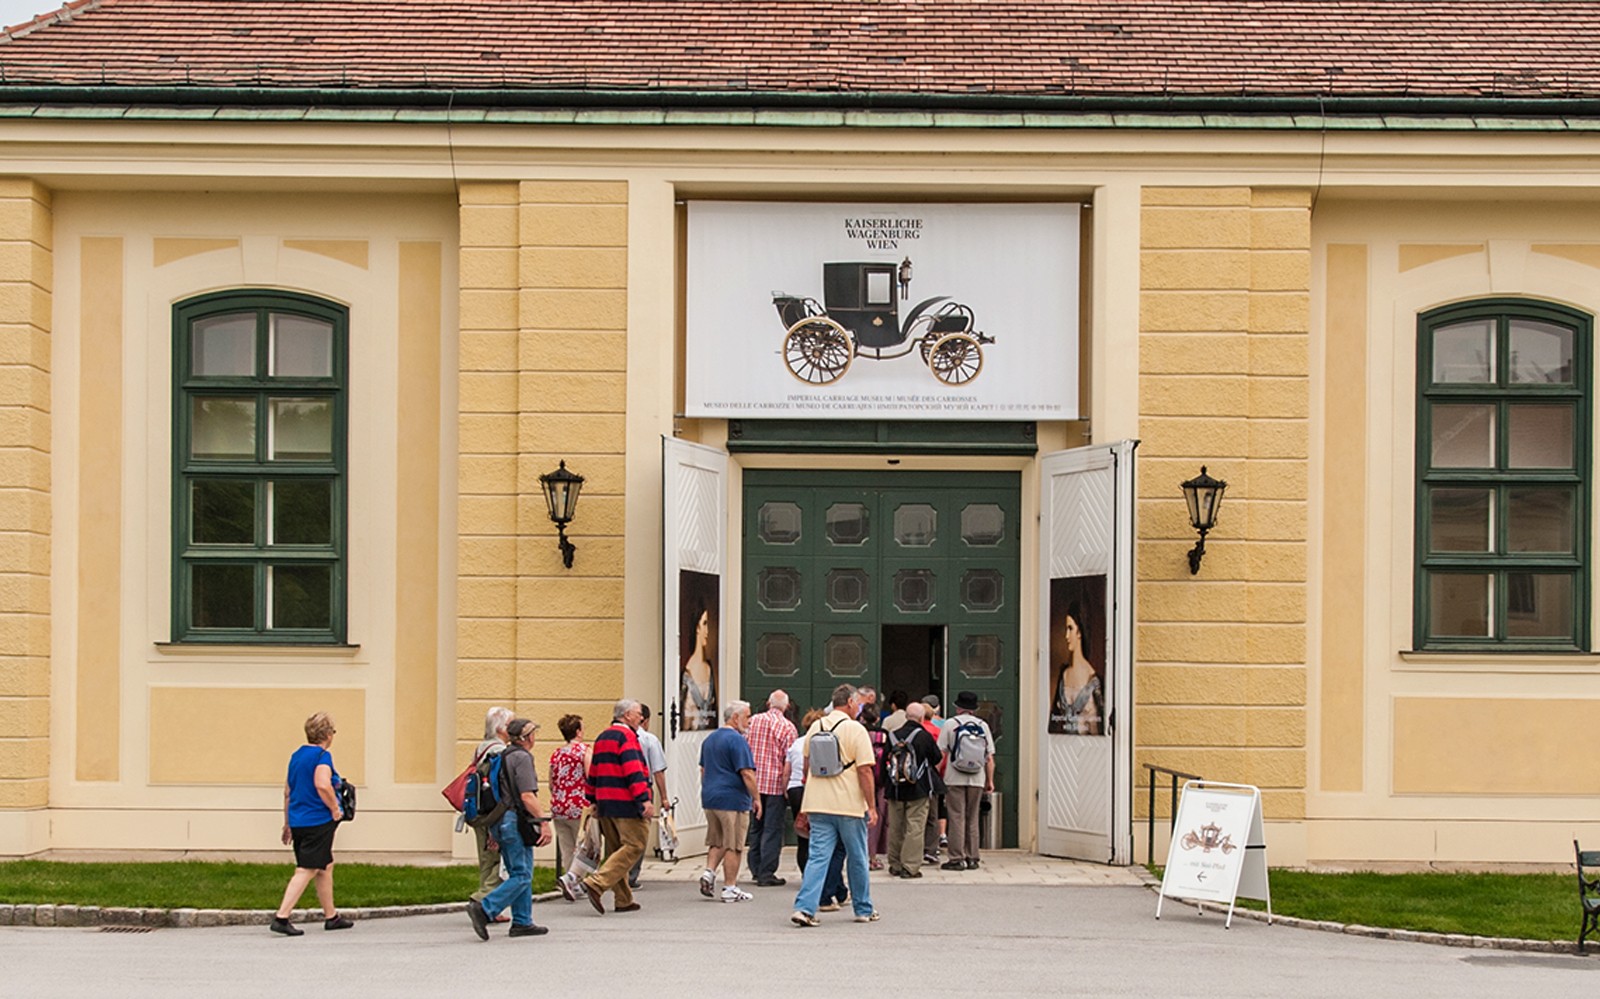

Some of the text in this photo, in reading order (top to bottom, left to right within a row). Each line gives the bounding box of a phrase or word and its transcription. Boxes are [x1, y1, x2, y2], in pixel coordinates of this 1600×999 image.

[845, 219, 923, 229] KAISERLICHE
[847, 229, 920, 239] WAGENBURG
[866, 239, 898, 249] WIEN
[896, 394, 919, 402] MUSÉE
[832, 403, 873, 411] CARRUAJES
